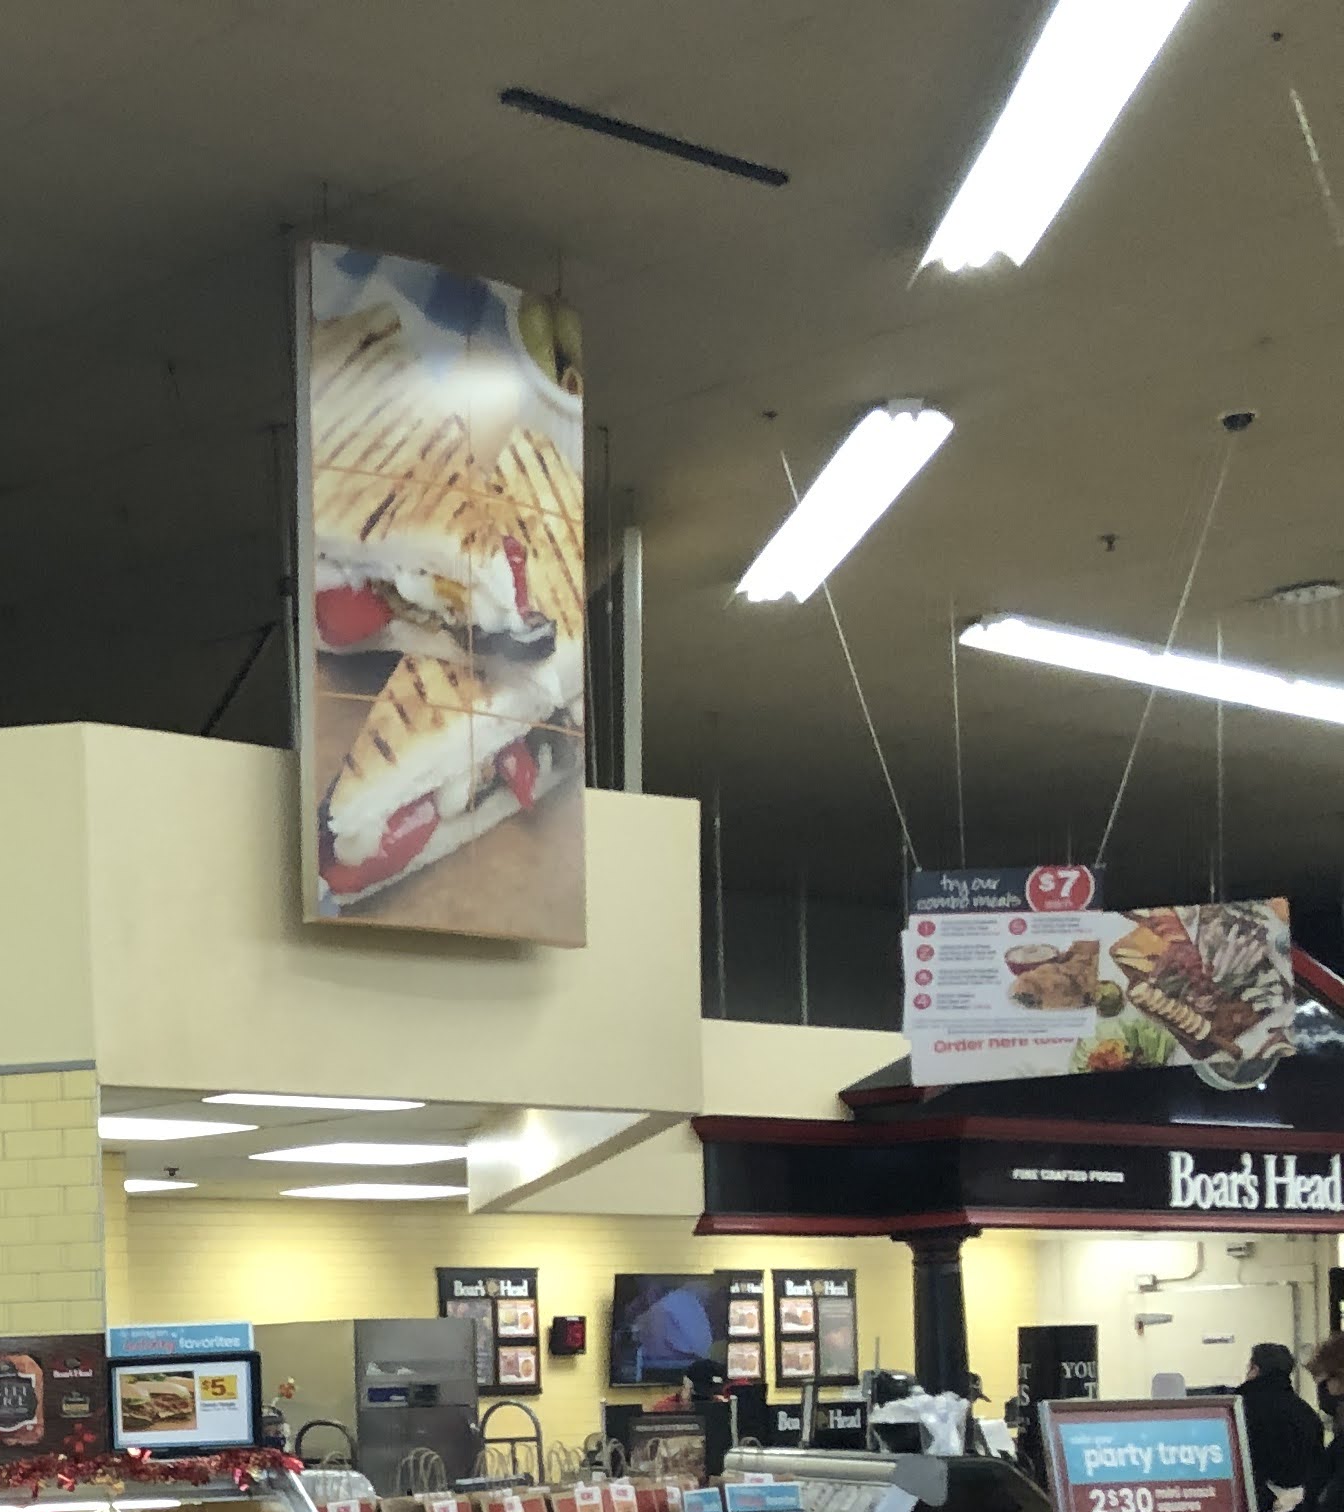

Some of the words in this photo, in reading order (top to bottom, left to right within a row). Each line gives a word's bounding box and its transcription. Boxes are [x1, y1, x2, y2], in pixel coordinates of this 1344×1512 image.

[1038, 869, 1080, 898] $7
[1168, 1150, 1260, 1211] Boar's
[1263, 1152, 1344, 1213] Head
[178, 1335, 241, 1350] favorites
[201, 1378, 227, 1397] $5
[829, 1407, 862, 1430] Head
[1084, 1444, 1152, 1476] party
[1158, 1442, 1224, 1474] trays
